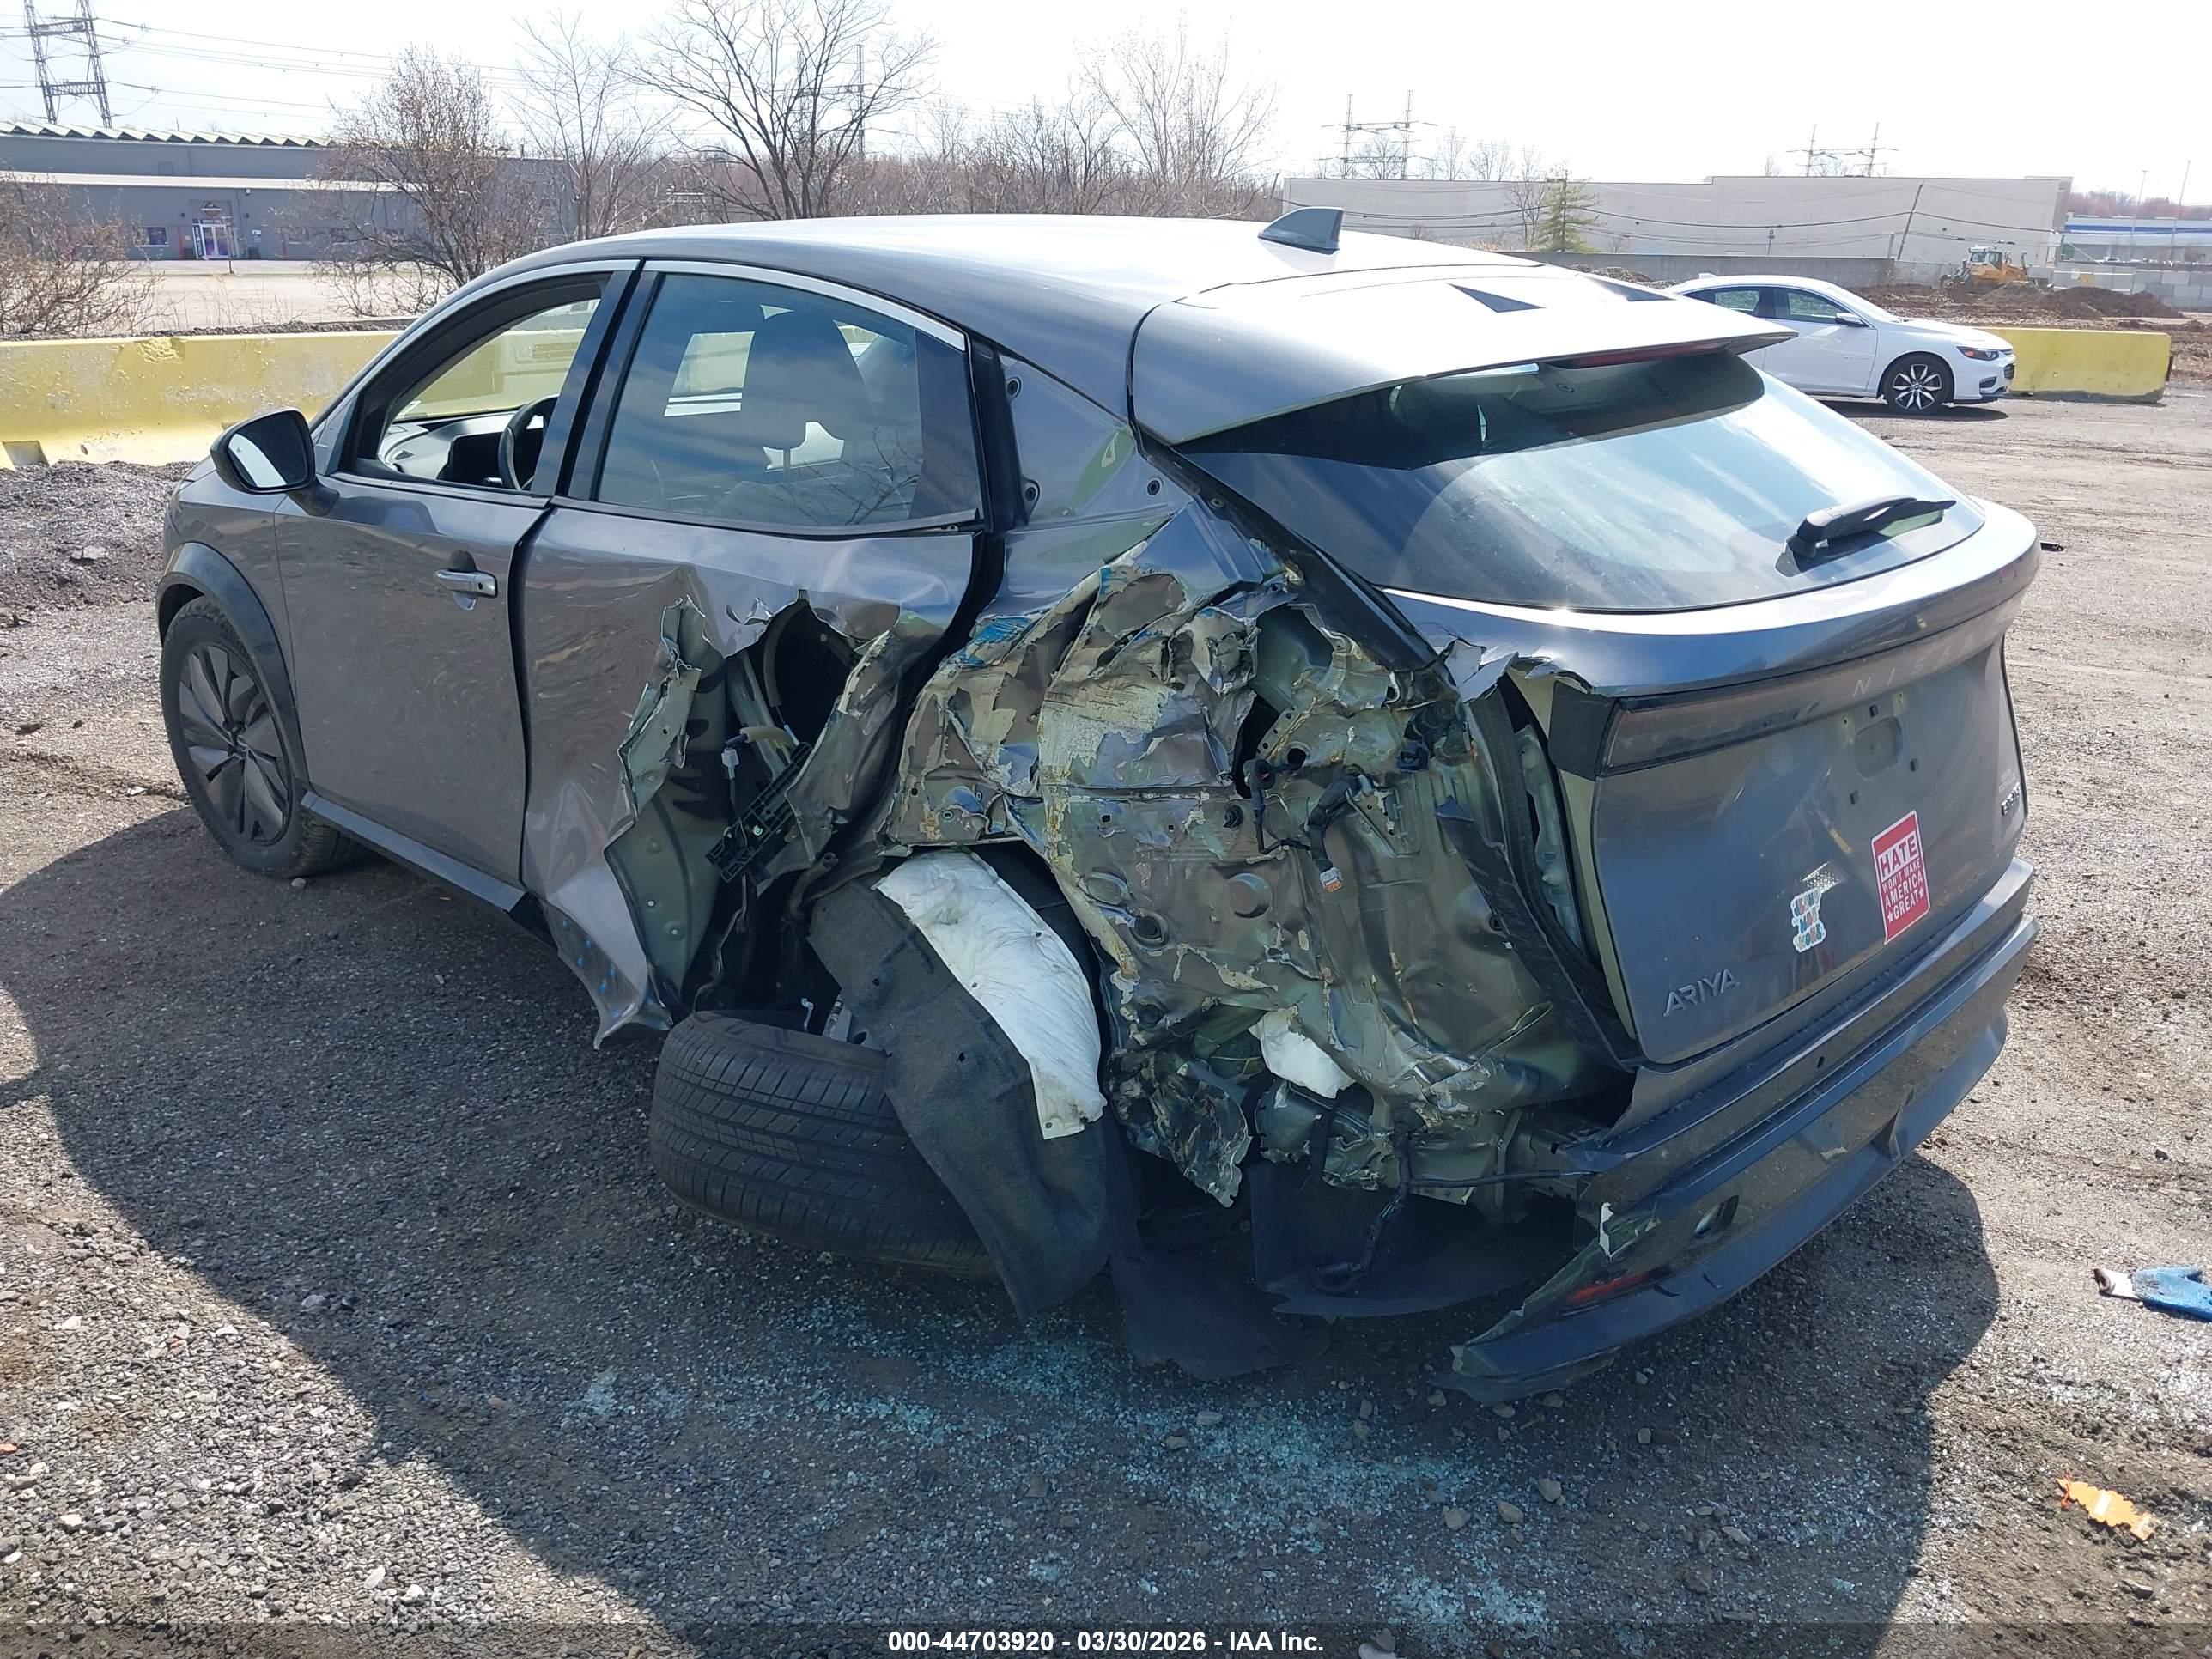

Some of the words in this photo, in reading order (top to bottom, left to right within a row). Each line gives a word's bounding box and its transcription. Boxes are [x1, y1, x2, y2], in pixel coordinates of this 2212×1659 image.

[1880, 835, 1917, 878] HATE
[1882, 869, 1902, 894] WON'T
[1904, 857, 1922, 878] MAKE
[1885, 871, 1923, 910] AMERICA
[1893, 890, 1920, 920] GREAT
[1663, 969, 1740, 1017] ARIYA
